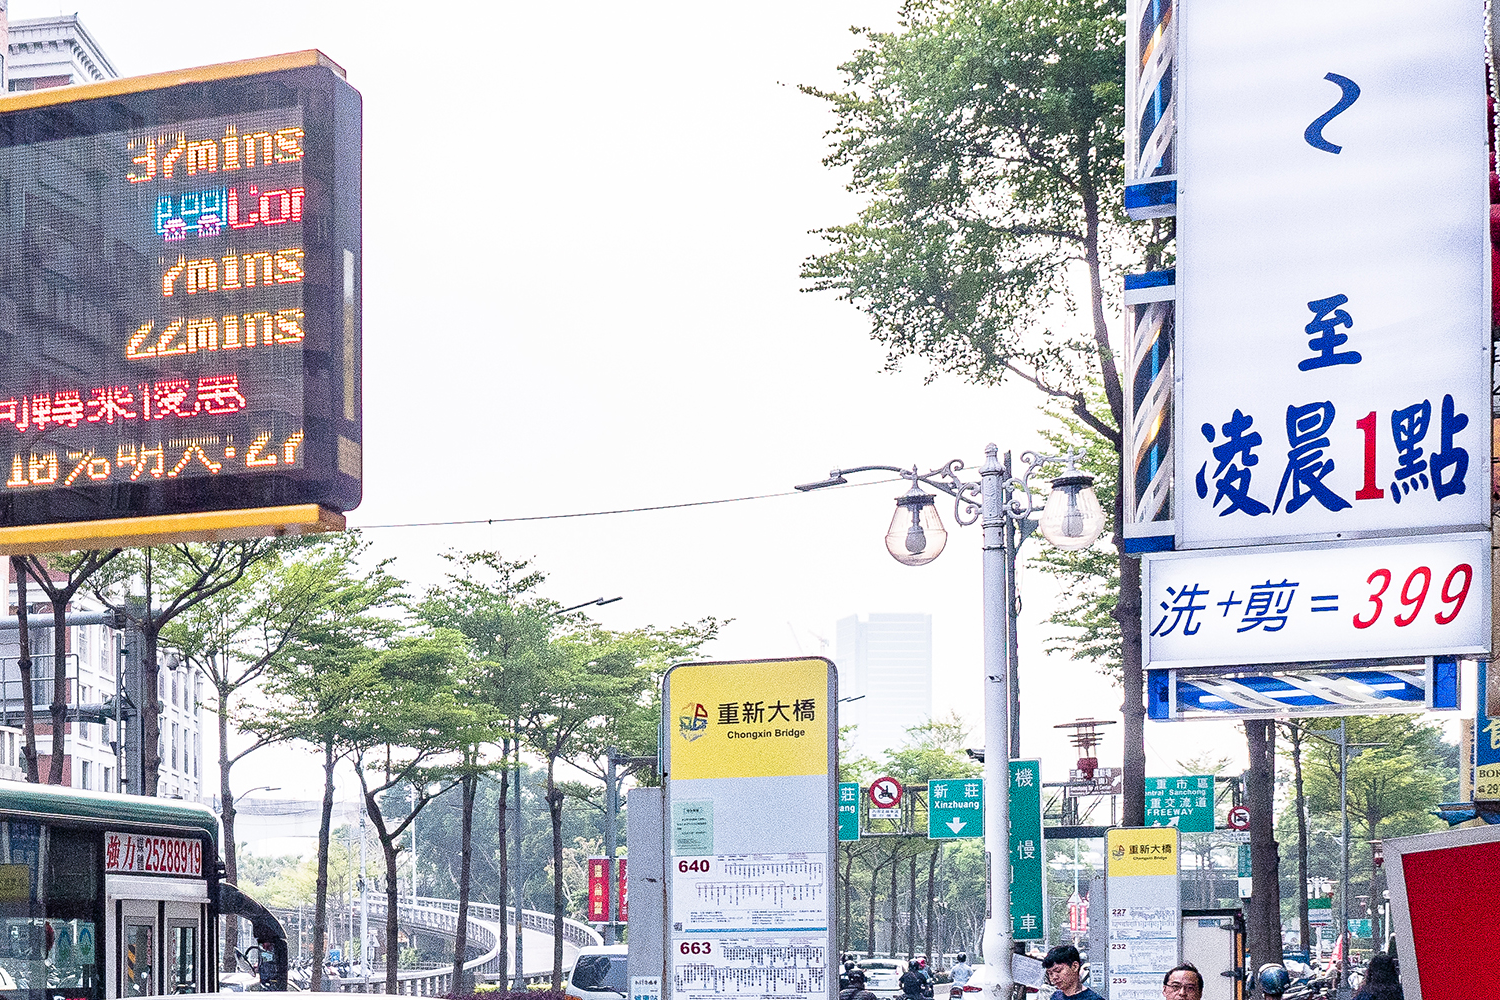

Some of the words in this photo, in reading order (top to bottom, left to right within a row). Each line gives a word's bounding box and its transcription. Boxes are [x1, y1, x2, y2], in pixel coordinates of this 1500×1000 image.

[1298, 294, 1363, 372] 至
[1195, 394, 1470, 516] 凌晨1點
[717, 698, 816, 725] 重新大橋
[727, 730, 772, 740] Chongxin
[774, 728, 806, 739] Bridge
[1145, 778, 1208, 789] 重市區
[934, 784, 979, 798] 新莊
[934, 801, 980, 810] Xinzhuang
[1145, 797, 1206, 808] 重交流道
[1147, 808, 1194, 816] FREEWAY
[107, 835, 136, 870] 強力
[145, 837, 202, 874] 25288919
[1128, 844, 1172, 855] 重新大橋
[678, 860, 710, 873] 640
[680, 941, 712, 954] 663
